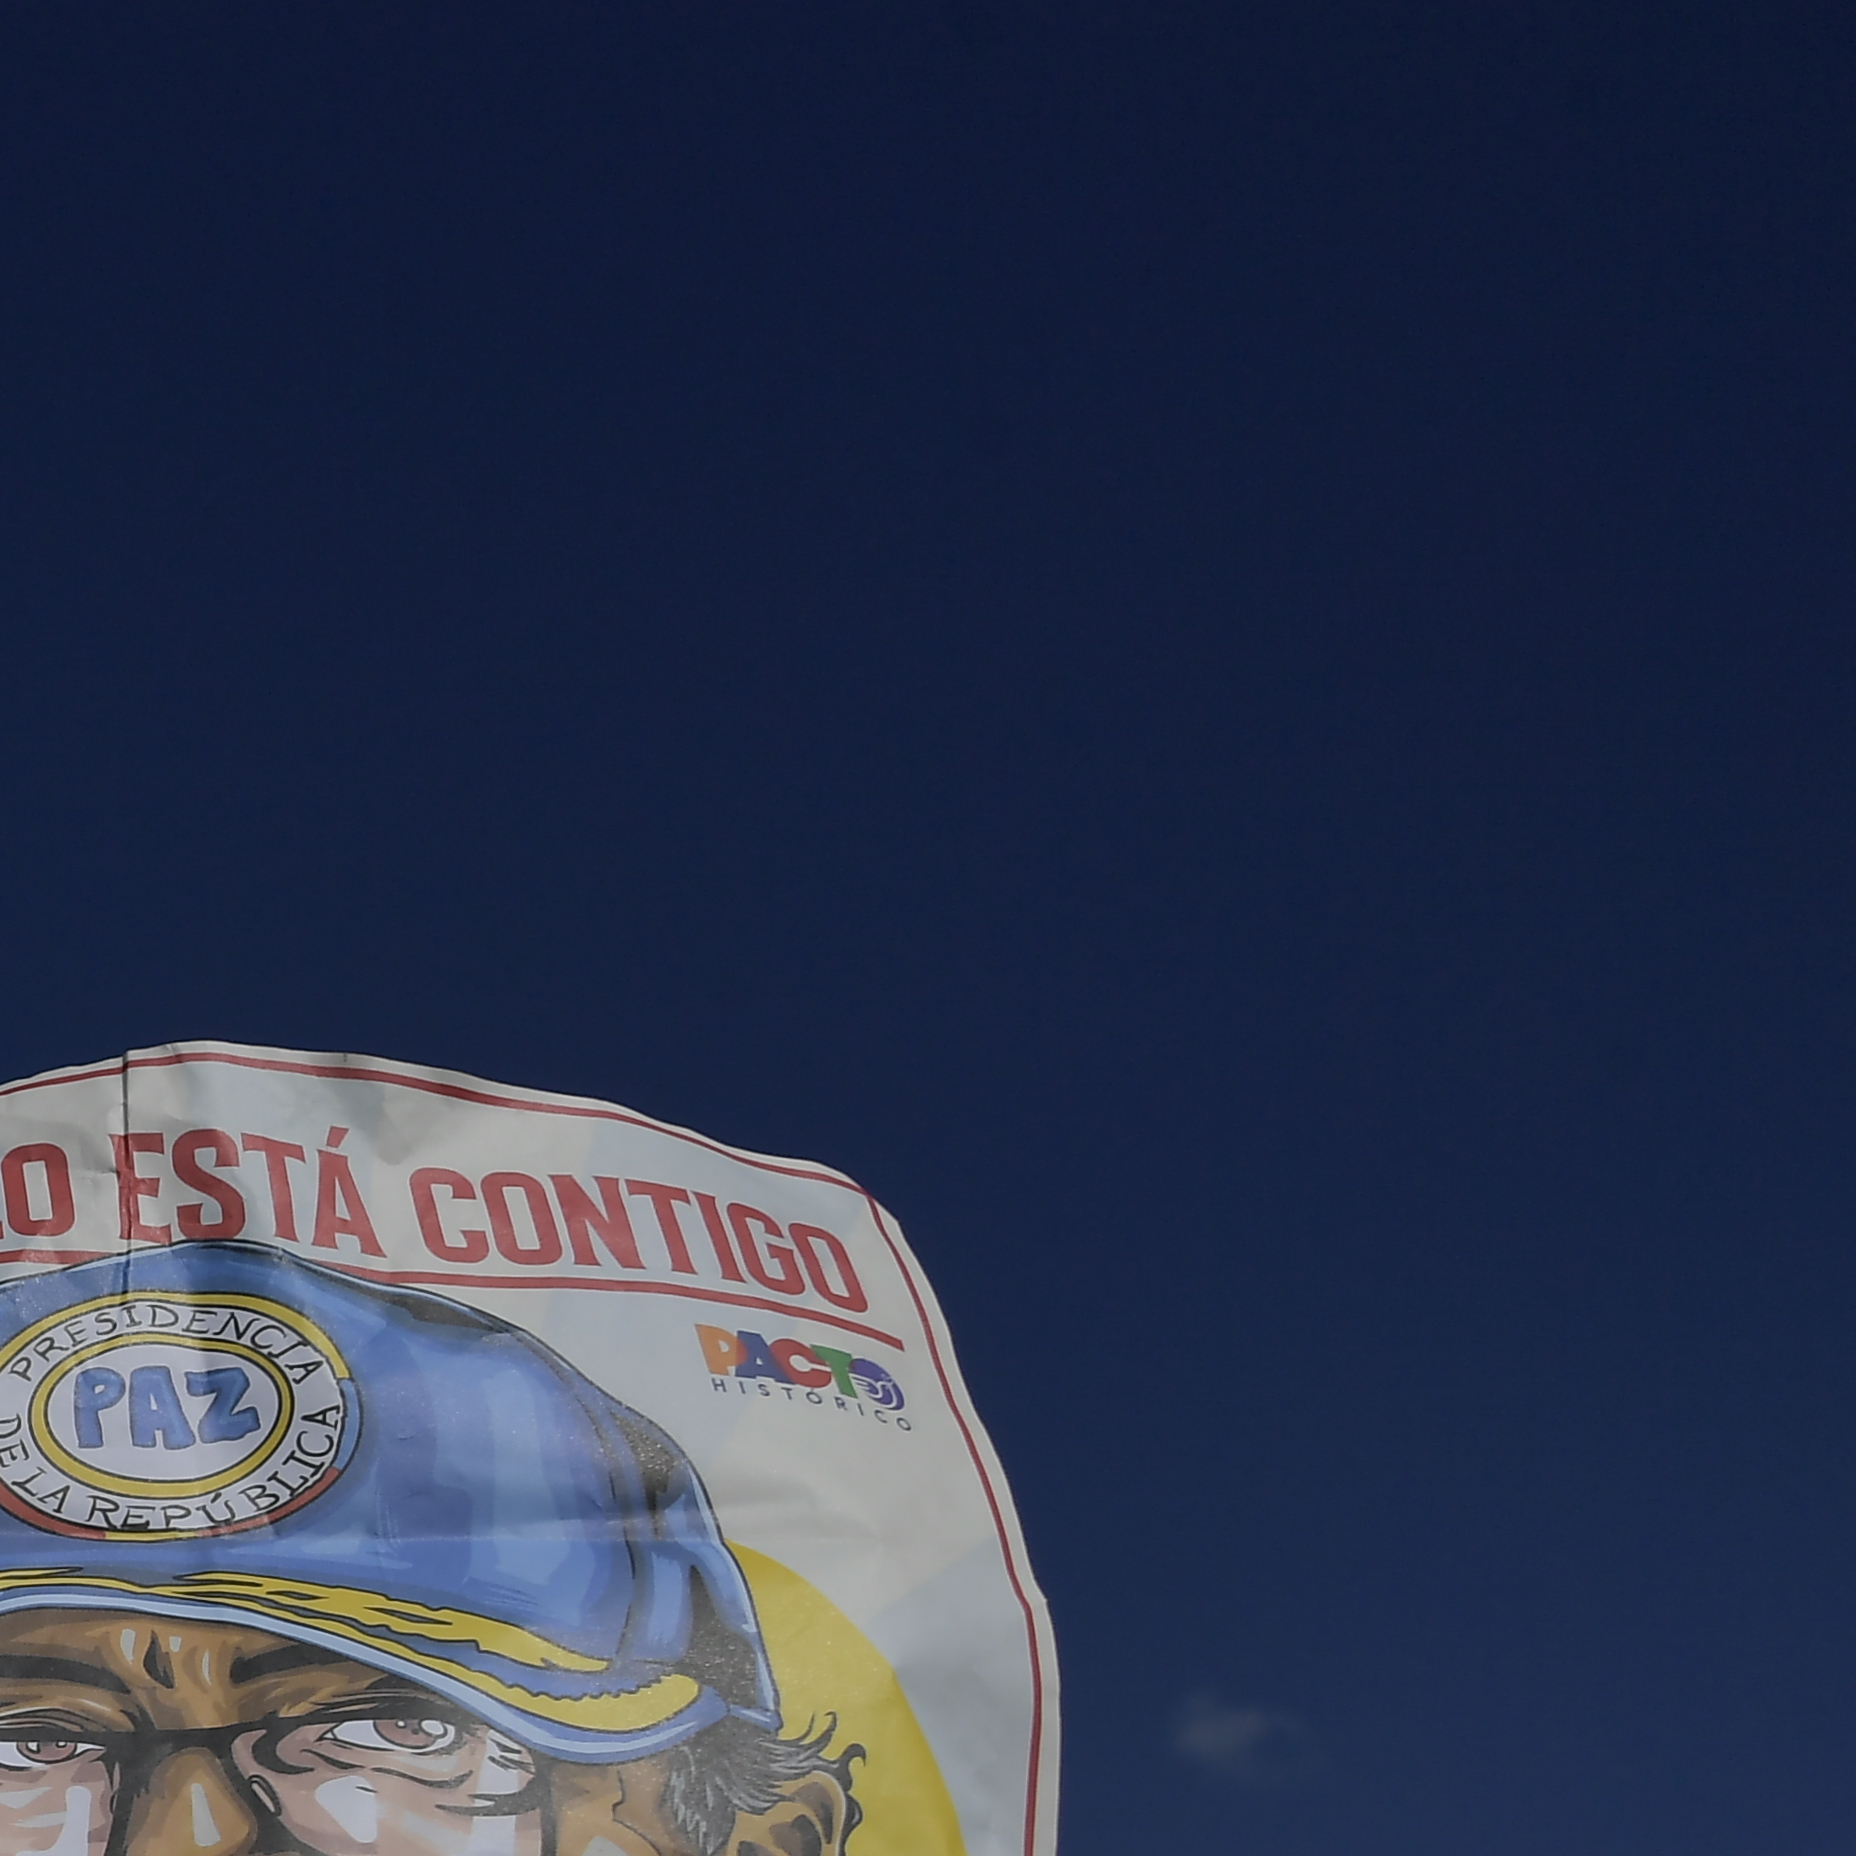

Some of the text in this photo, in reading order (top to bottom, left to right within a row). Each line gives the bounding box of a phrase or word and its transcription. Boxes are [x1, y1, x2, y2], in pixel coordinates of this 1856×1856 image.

[109, 1126, 387, 1258] ESTÁ
[409, 1167, 868, 1313] CONTIGO
[9, 1304, 328, 1386] PRESIDENCIA
[694, 1323, 905, 1411] PACTO
[73, 1365, 261, 1450] PAZ
[711, 1377, 912, 1431] HISTÓRICO
[11, 1467, 71, 1514] LA
[85, 1403, 341, 1530] REPÚBLICA
